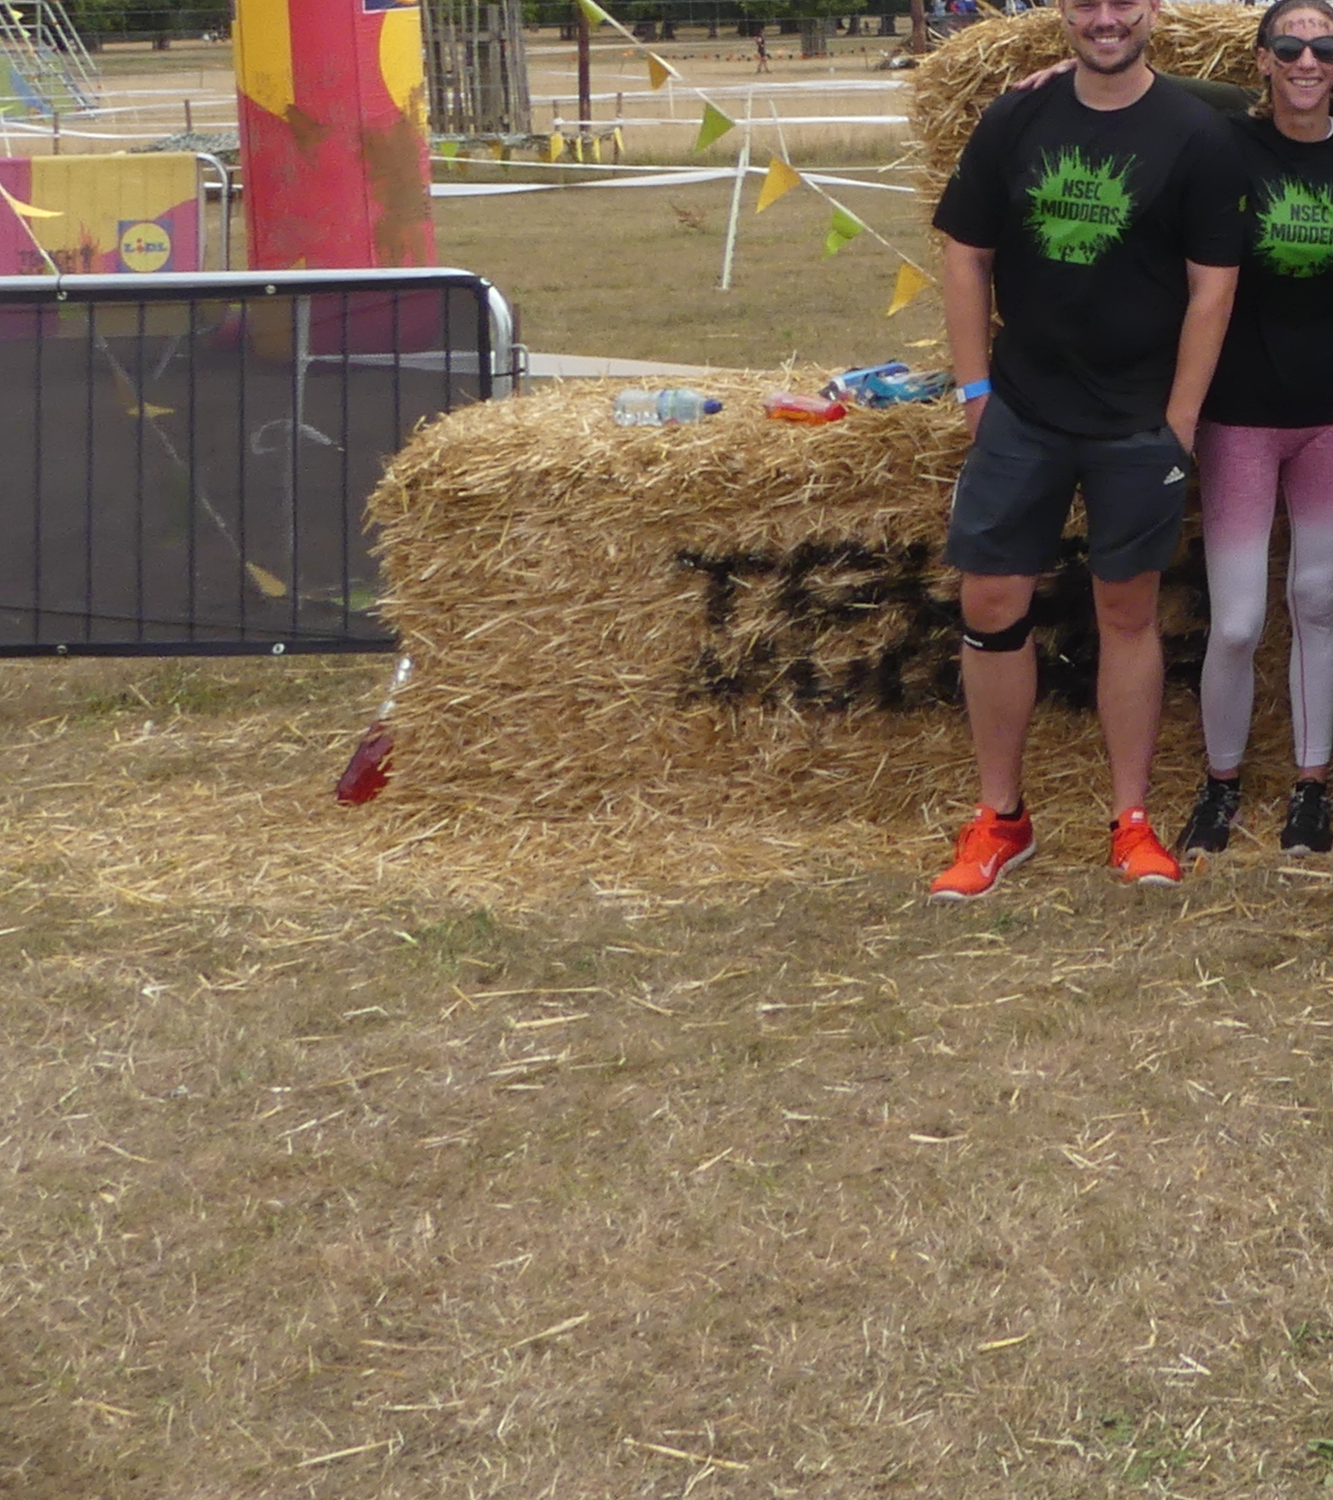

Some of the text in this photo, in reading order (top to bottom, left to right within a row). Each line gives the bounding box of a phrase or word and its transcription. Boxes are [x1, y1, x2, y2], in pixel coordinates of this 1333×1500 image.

[1062, 178, 1102, 200] NSEC
[1040, 200, 1120, 225] MUDDERS
[1290, 203, 1329, 223] NSEC
